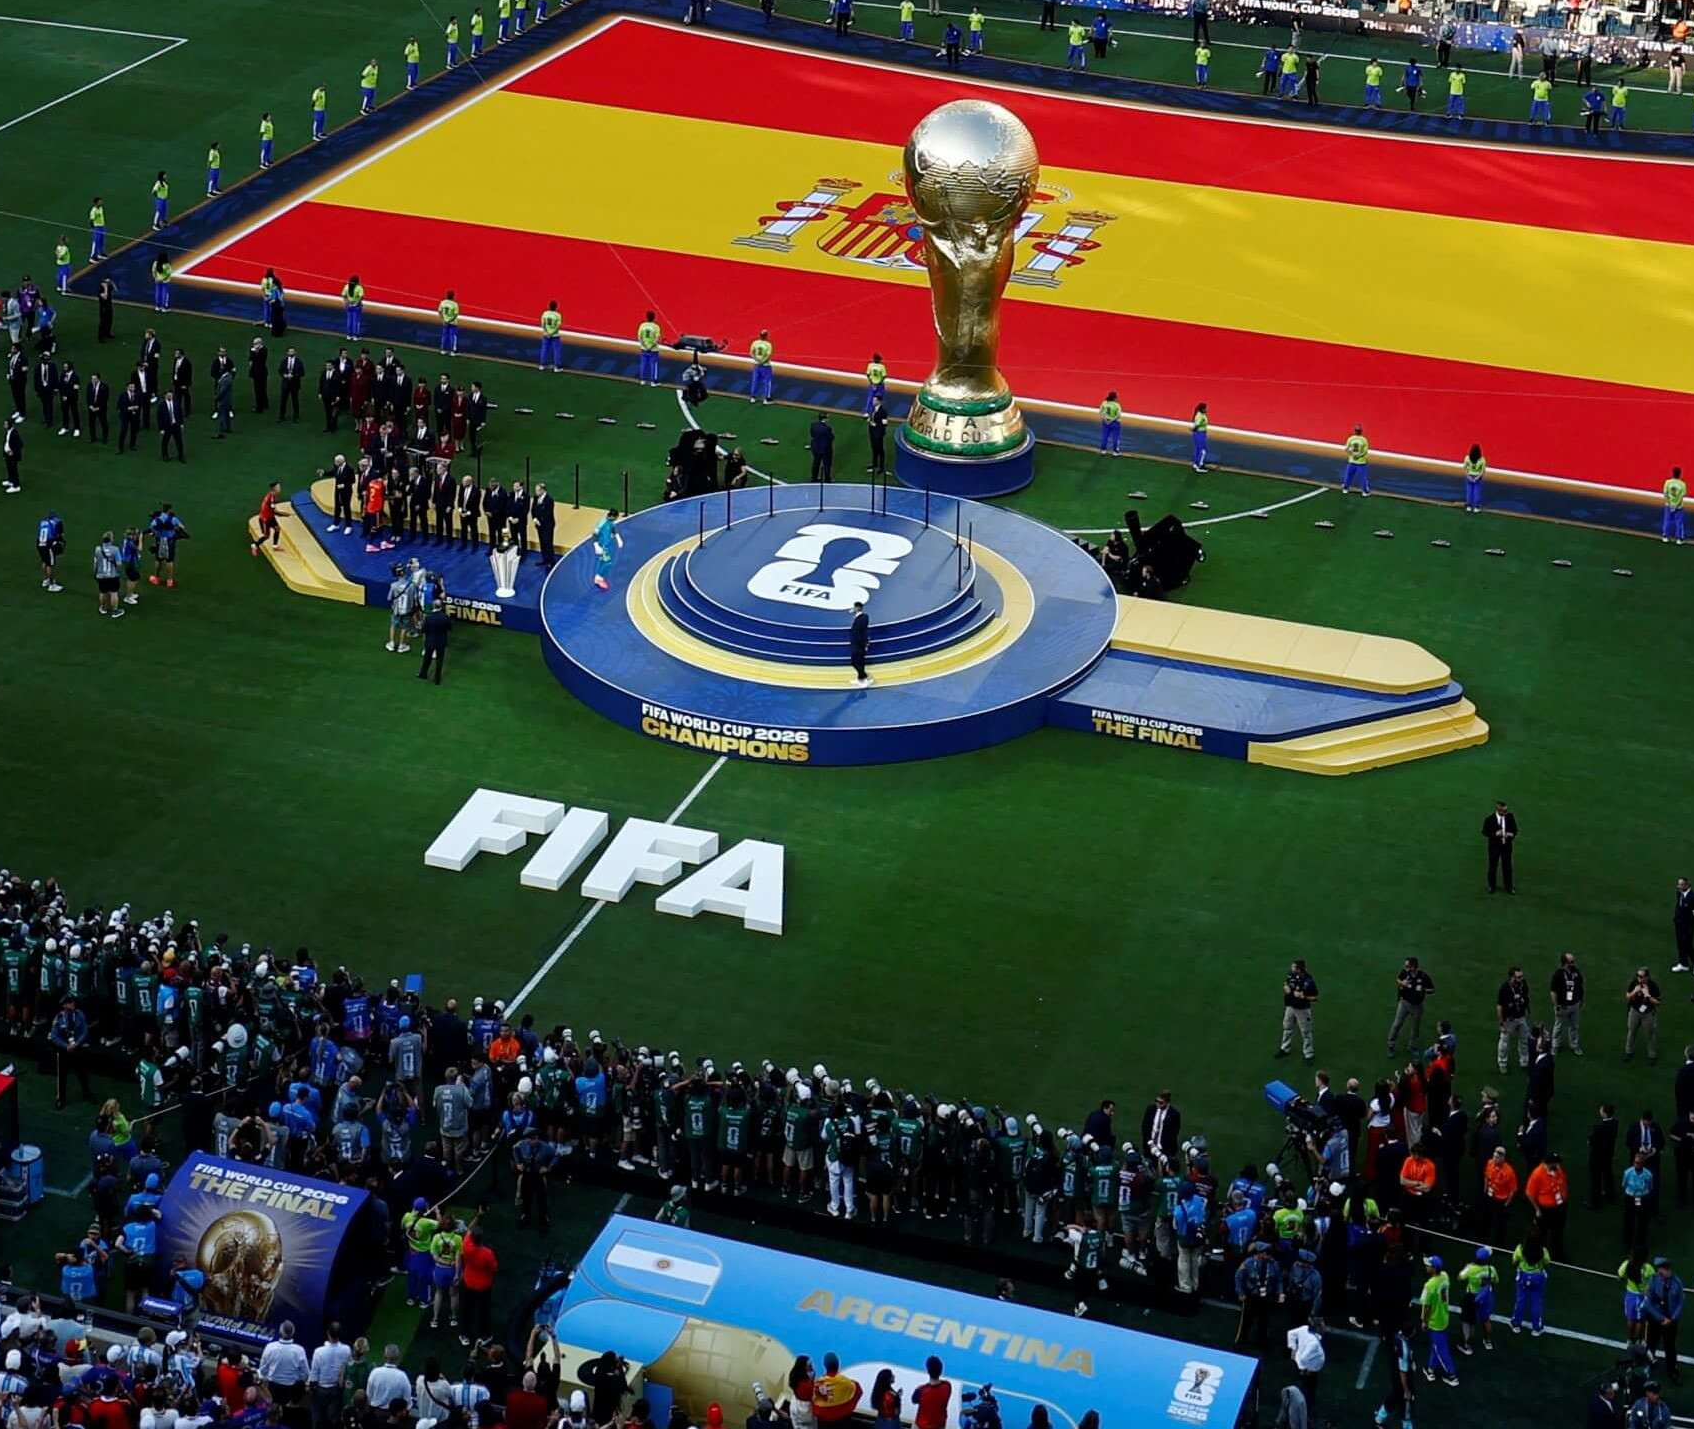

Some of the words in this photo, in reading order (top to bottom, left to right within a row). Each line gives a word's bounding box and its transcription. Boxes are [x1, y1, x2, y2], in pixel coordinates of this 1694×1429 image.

[1300, 4, 1322, 15] CUP
[1364, 20, 1386, 31] THE
[1638, 41, 1660, 52] FIFA
[919, 408, 978, 429] FIFA
[779, 584, 831, 601] FIFA
[445, 604, 502, 625] FINAL
[454, 597, 471, 606] CUP
[472, 599, 502, 613] 2026
[642, 702, 668, 721] FIFA
[669, 710, 721, 733] WORLD
[722, 722, 752, 737] CUP
[754, 728, 809, 744] 2026
[1091, 709, 1113, 721] FIFA
[1114, 714, 1149, 727] WORLD
[1149, 719, 1169, 729] CUP
[1169, 722, 1203, 736] 2026
[642, 717, 809, 763] CHAMPIONS
[1092, 718, 1135, 738] THE
[1138, 727, 1203, 751] FINAL
[423, 786, 785, 936] FIFA
[195, 1163, 223, 1178] FIFA
[225, 1169, 276, 1190] WORLD
[275, 1179, 301, 1195] CUP
[300, 1185, 350, 1205] 2026
[190, 1171, 244, 1200] THE
[248, 1184, 338, 1222] FINAL
[796, 1288, 1096, 1378] ARGENTINA
[1184, 1392, 1203, 1402] FIFA
[1167, 1406, 1208, 1422] 2026
